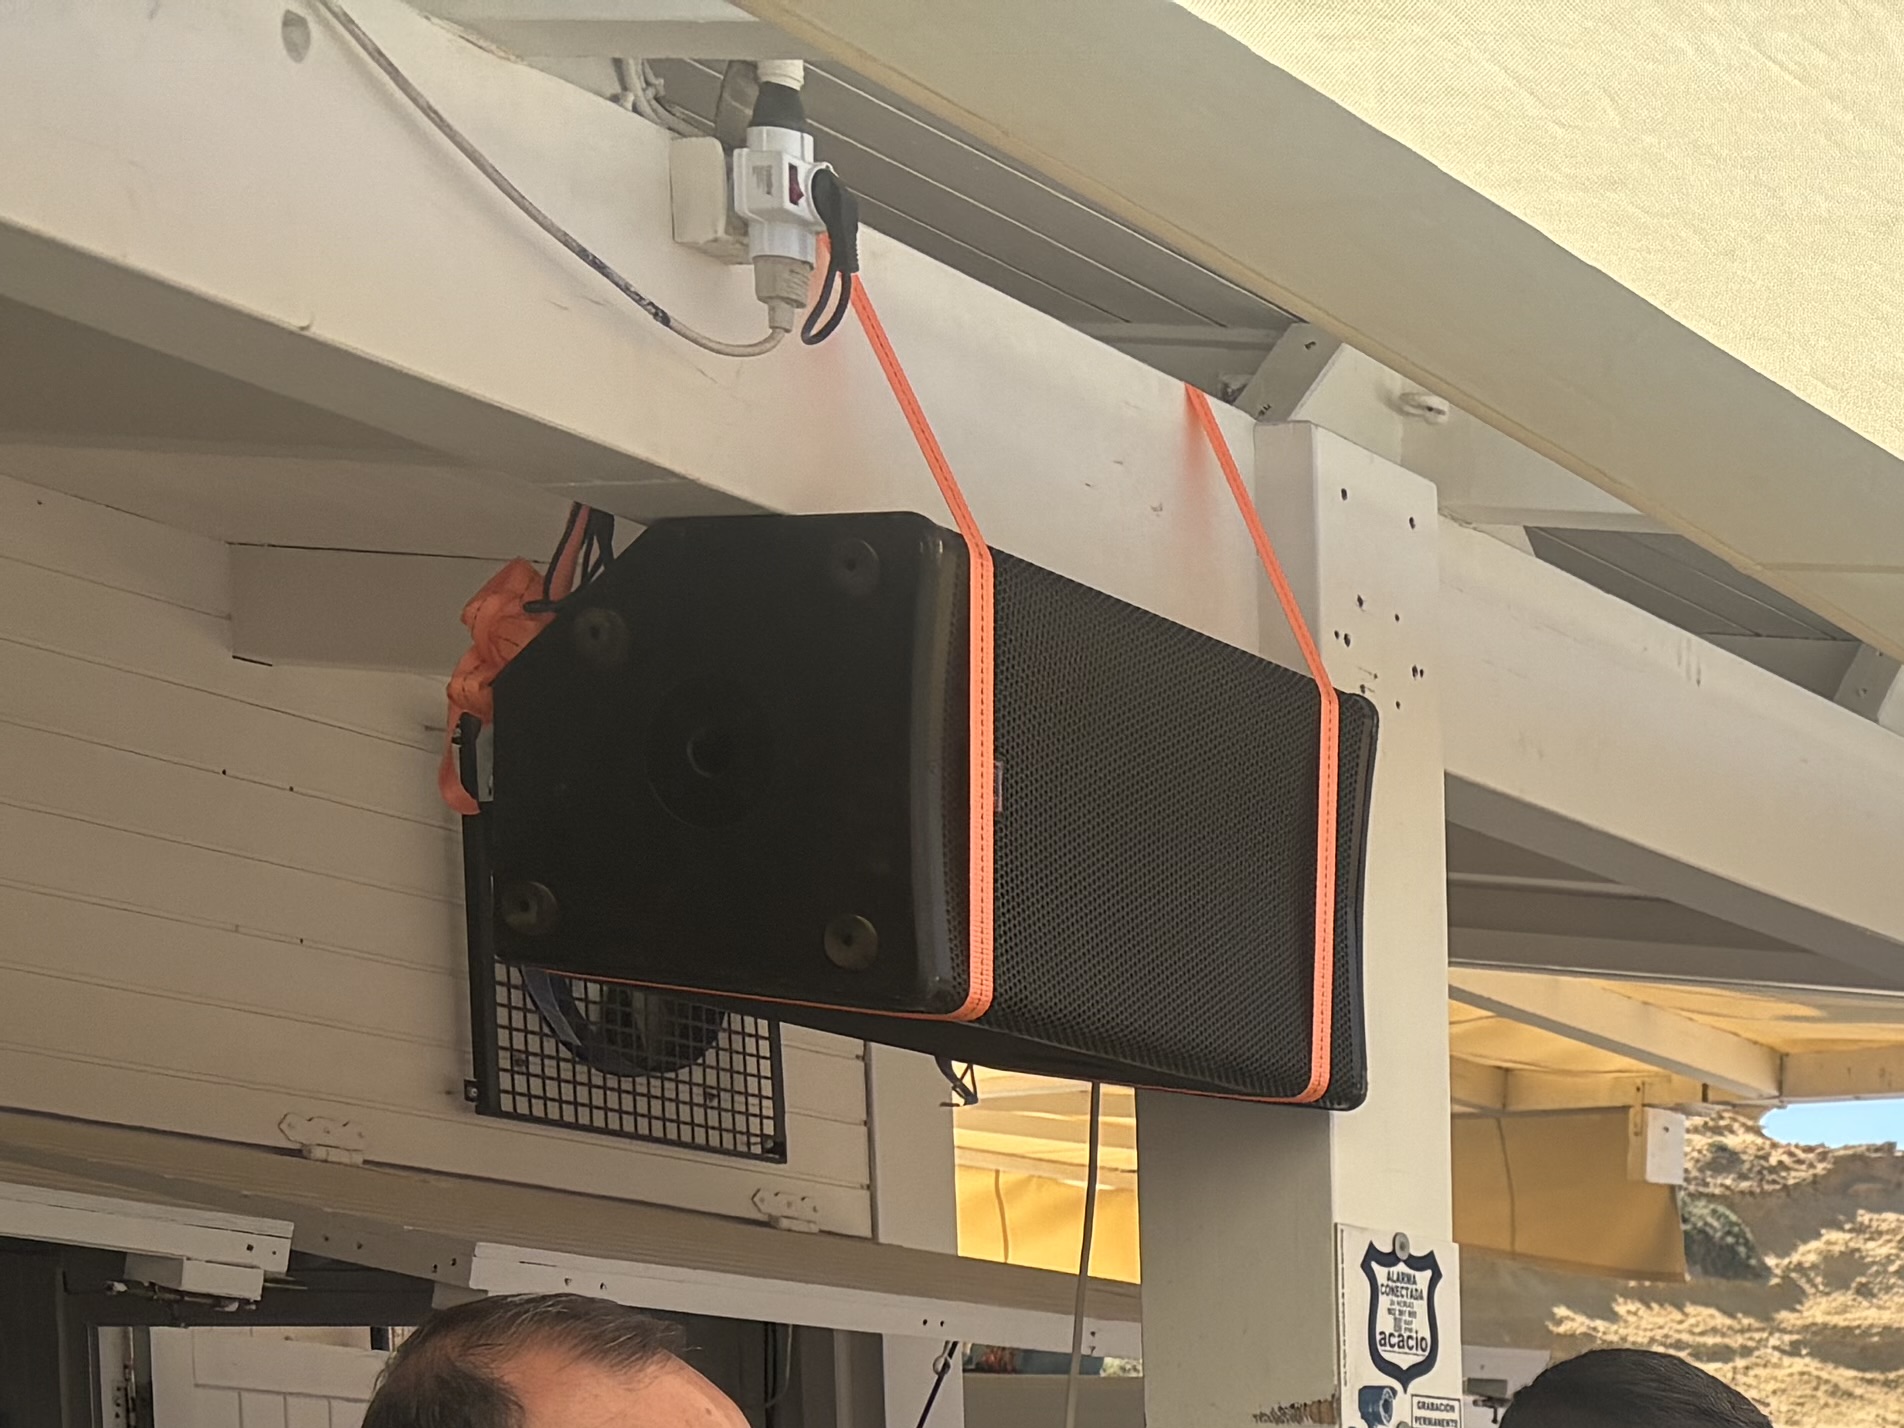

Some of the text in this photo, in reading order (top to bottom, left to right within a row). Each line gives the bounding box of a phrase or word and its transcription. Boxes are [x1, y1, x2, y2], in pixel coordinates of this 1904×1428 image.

[1387, 1270, 1417, 1285] ALARMA
[1380, 1283, 1424, 1300] CONECTADA
[1379, 1329, 1428, 1352] acacio
